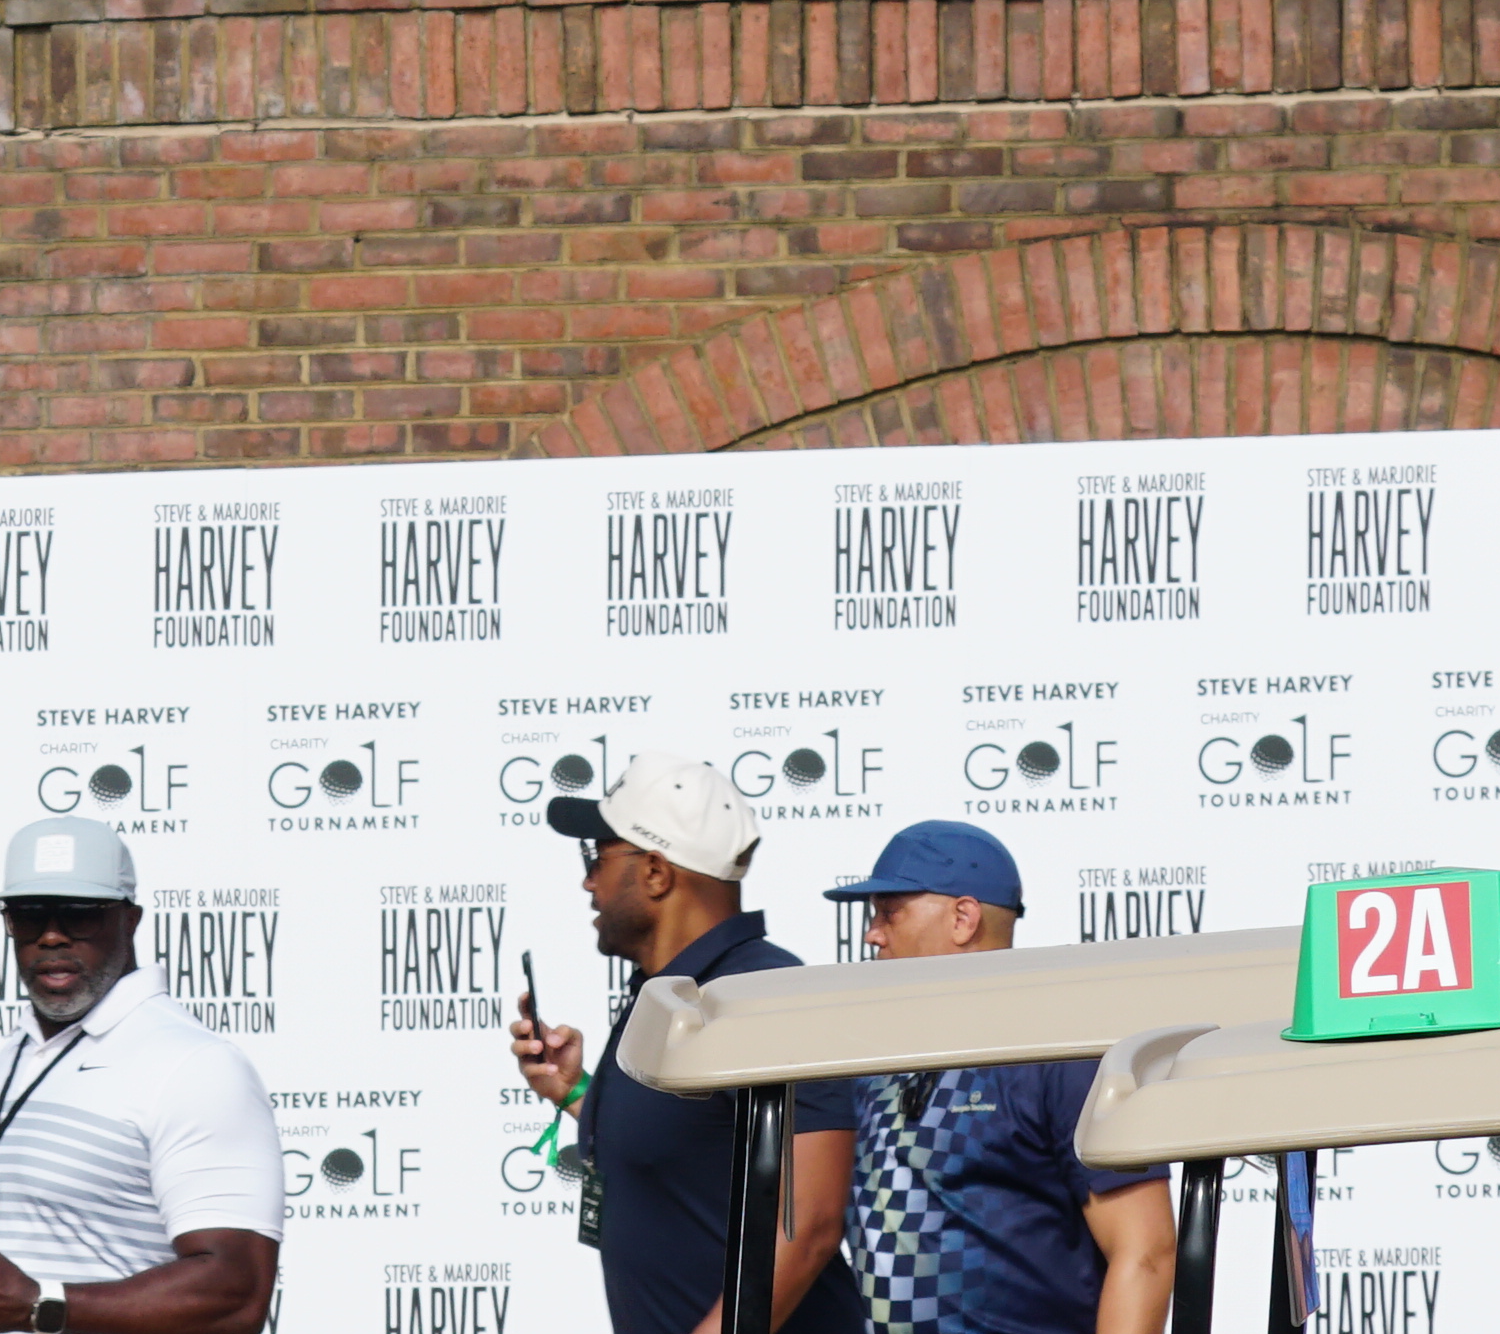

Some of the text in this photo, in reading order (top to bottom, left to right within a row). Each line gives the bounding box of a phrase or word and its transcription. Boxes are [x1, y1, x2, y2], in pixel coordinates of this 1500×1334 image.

[1079, 473, 1204, 494] STEVE & MARJORIE
[1308, 465, 1435, 486] STEVE & MARJORIE
[608, 489, 732, 510] STEVE & MARJORIE
[155, 503, 279, 522] STEVE & MARJORIE
[1079, 496, 1203, 586] HARVEY
[1309, 488, 1434, 578] HARVEY
[608, 512, 731, 600] HARVEY
[155, 525, 278, 612] HARVEY
[1078, 588, 1199, 622] FOUNDATION
[1308, 580, 1429, 615] FOUNDATION
[607, 602, 727, 636] FOUNDATION
[154, 615, 273, 648] FOUNDATION
[1198, 675, 1352, 696] STEVE HARVEY
[1433, 671, 1492, 688] STEVE
[963, 683, 1118, 703] STEVE HARVEY
[268, 702, 420, 722] STEVE HARVEY
[1201, 712, 1259, 725] CHARITY
[1435, 705, 1495, 717] CHARITY
[966, 718, 1025, 731] CHARITY
[270, 738, 328, 750] CHARITY
[965, 797, 1116, 814] TOURNAMENT
[1200, 791, 1350, 807] TOURNAMENT
[269, 815, 418, 831] TOURNAMENT
[381, 884, 505, 904] STEVE & MARJORIE
[382, 907, 504, 994] HARVEY
[1350, 887, 1458, 994] 2A
[382, 997, 501, 1030] FOUNDATION
[270, 1091, 421, 1108] STEVE HARVEY
[284, 1204, 421, 1219] OURNAMENT
[1315, 1247, 1440, 1267] STEVE & MARJORIE
[385, 1263, 510, 1283] STEVE & MARJORIE
